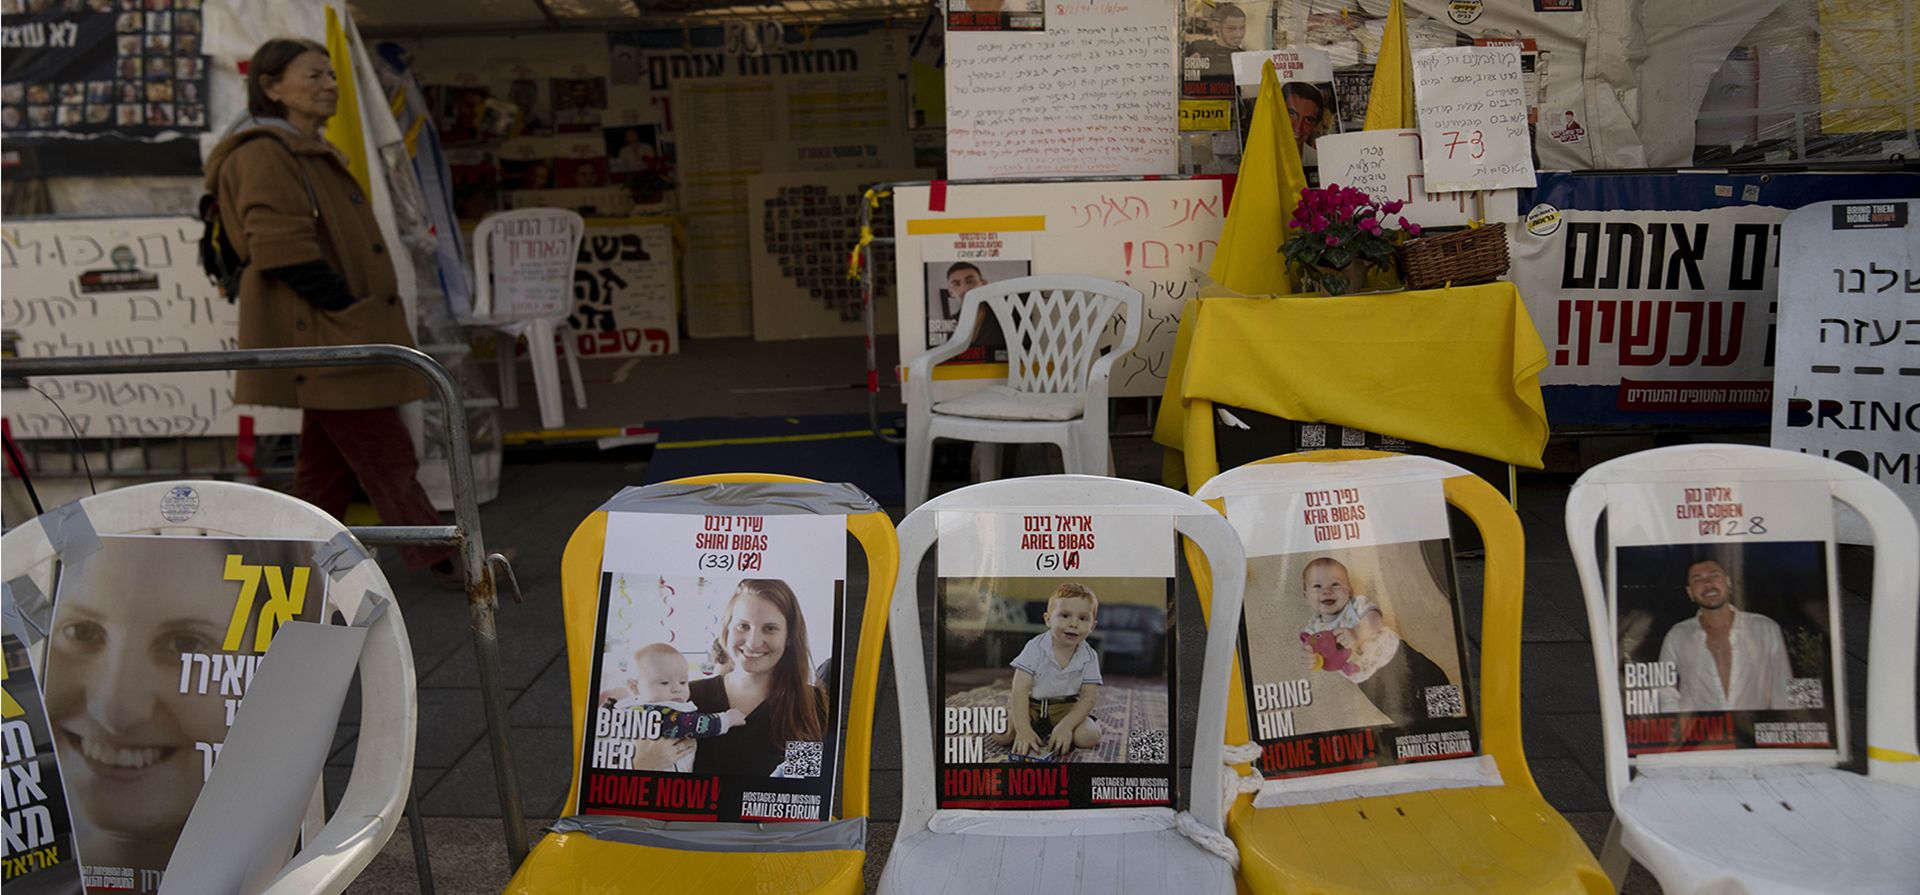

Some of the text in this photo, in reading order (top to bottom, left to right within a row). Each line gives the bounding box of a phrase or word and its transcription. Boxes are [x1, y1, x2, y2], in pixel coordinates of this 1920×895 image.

[1184, 57, 1210, 69] BRING
[1184, 70, 1201, 80] HIM
[1442, 130, 1486, 159] 73
[1164, 195, 1217, 228] אני
[1846, 204, 1895, 214] BRING THEM
[1846, 213, 1871, 224] HOME
[1561, 222, 1709, 290] אותם
[578, 328, 672, 355] הסכם
[1555, 300, 1745, 366] עכשיו!
[1627, 388, 1677, 403] והנעדרים
[1679, 388, 1726, 403] החטופים
[1304, 488, 1360, 508] כפיר ביבס
[1684, 486, 1732, 504] אליה כהן
[1303, 505, 1366, 526] KFIR BIBAS
[1677, 503, 1744, 519] ELIYA COHEN
[704, 515, 763, 533] שירי ביבס
[1024, 514, 1092, 532] אריאל ביבס
[1314, 522, 1361, 544] (בן שנה)
[1725, 516, 1768, 536] 28
[695, 533, 768, 551] SHIRI BIBAS
[1021, 533, 1095, 550] ARIEL BIBAS
[698, 552, 735, 571] (33)
[1036, 552, 1060, 571] (5)
[1625, 661, 1678, 688] BRING
[1252, 678, 1313, 712] BRING
[1625, 689, 1660, 715] HIM
[596, 708, 662, 740] BRING
[944, 706, 1008, 734] BRING
[1256, 711, 1294, 741] HIM
[1627, 712, 1735, 744] HOME NOW!
[592, 740, 636, 770] HER
[944, 736, 984, 763] HIM
[1263, 727, 1375, 772] HOME NOW!
[1396, 739, 1472, 759] FAMILIES FORUM
[944, 765, 1069, 797] HOME NOW!
[1091, 777, 1169, 787] HOSTAGES AND MISSING
[589, 773, 720, 811] HOME NOW!
[743, 791, 821, 804] HOSTAGES AND MISSING
[1091, 787, 1169, 800] FAMILIES FORUM
[741, 802, 820, 820] FAMILIES FORUM
[1, 846, 60, 881] אריאל
